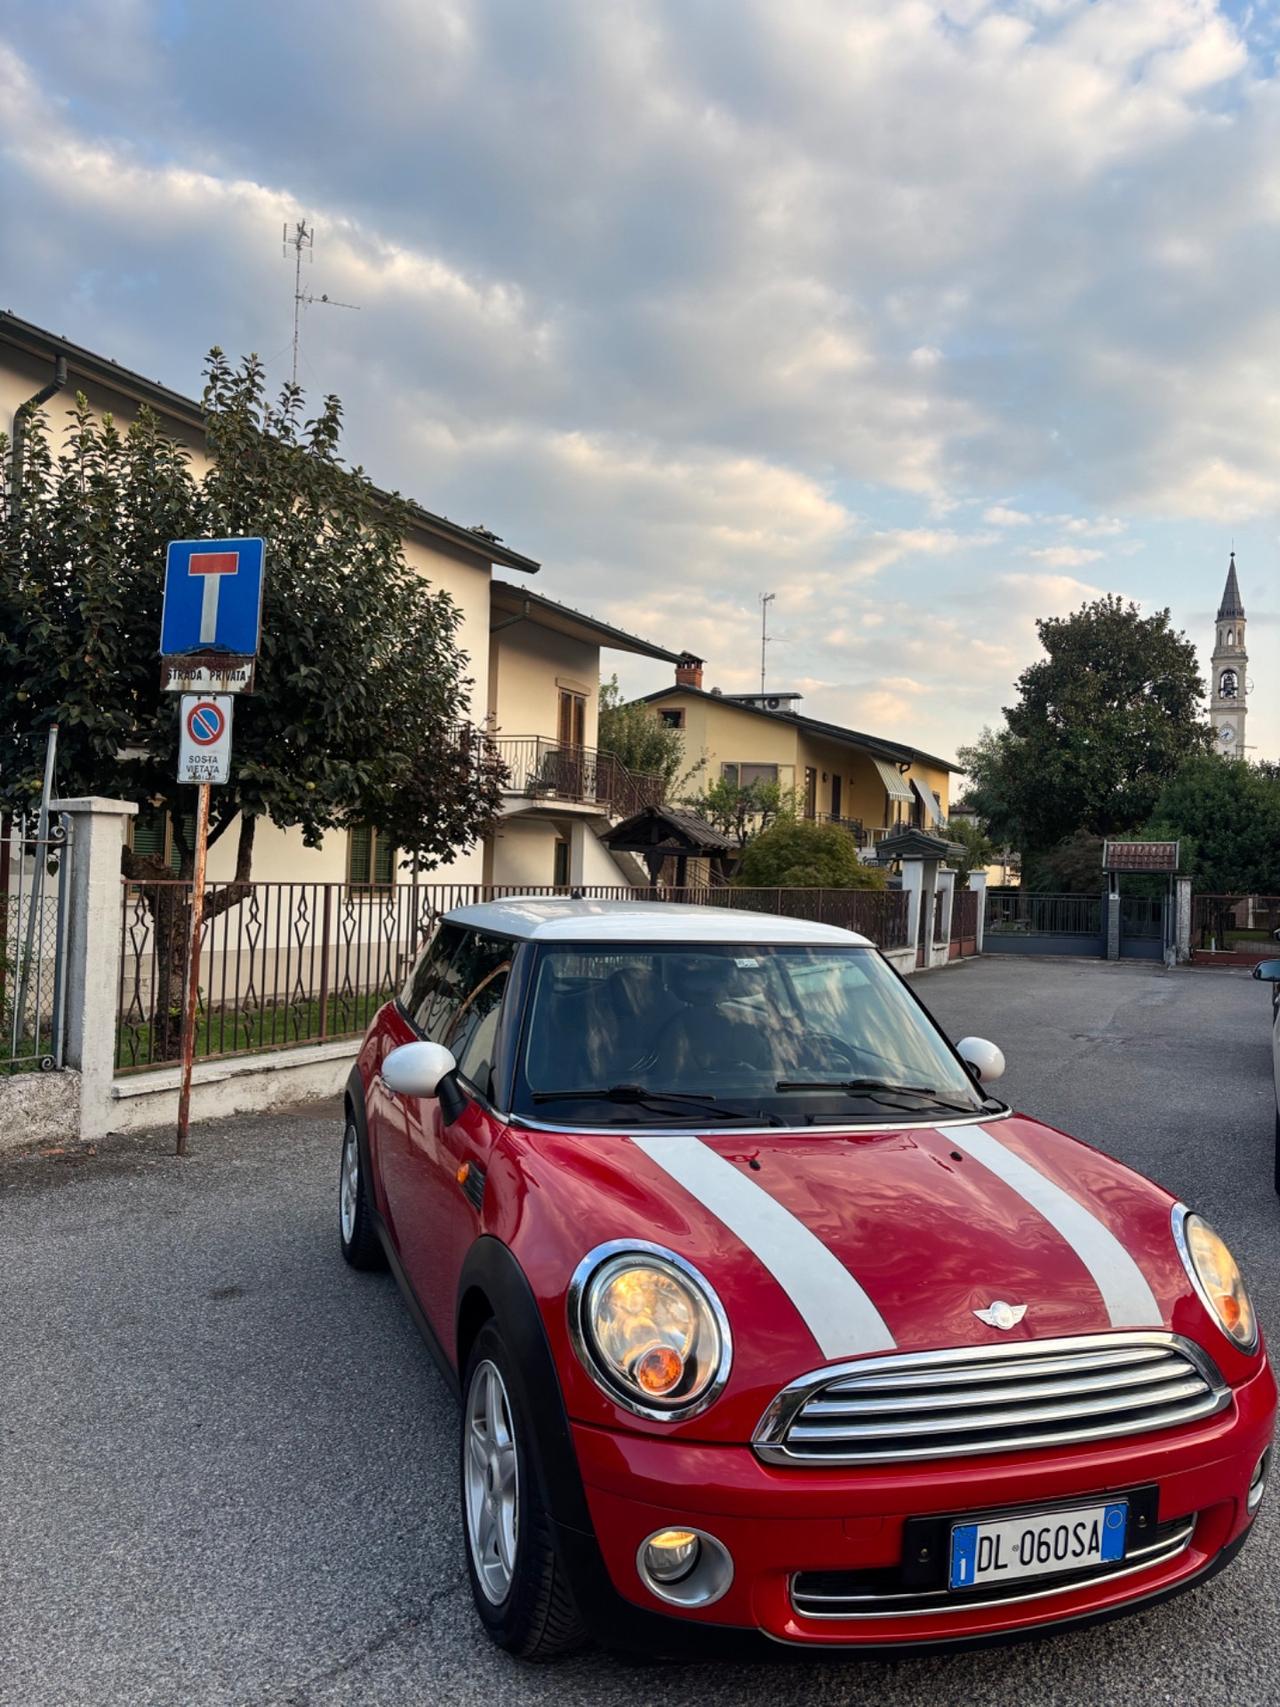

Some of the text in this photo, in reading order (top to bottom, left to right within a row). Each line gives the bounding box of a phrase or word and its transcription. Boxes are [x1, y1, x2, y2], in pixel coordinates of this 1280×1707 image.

[167, 669, 246, 681] STRADA PRIVATA
[188, 755, 218, 764] SOSTA
[186, 764, 220, 773] VIETATA
[976, 1533, 1008, 1573] DL
[1018, 1519, 1101, 1566] 060SA
